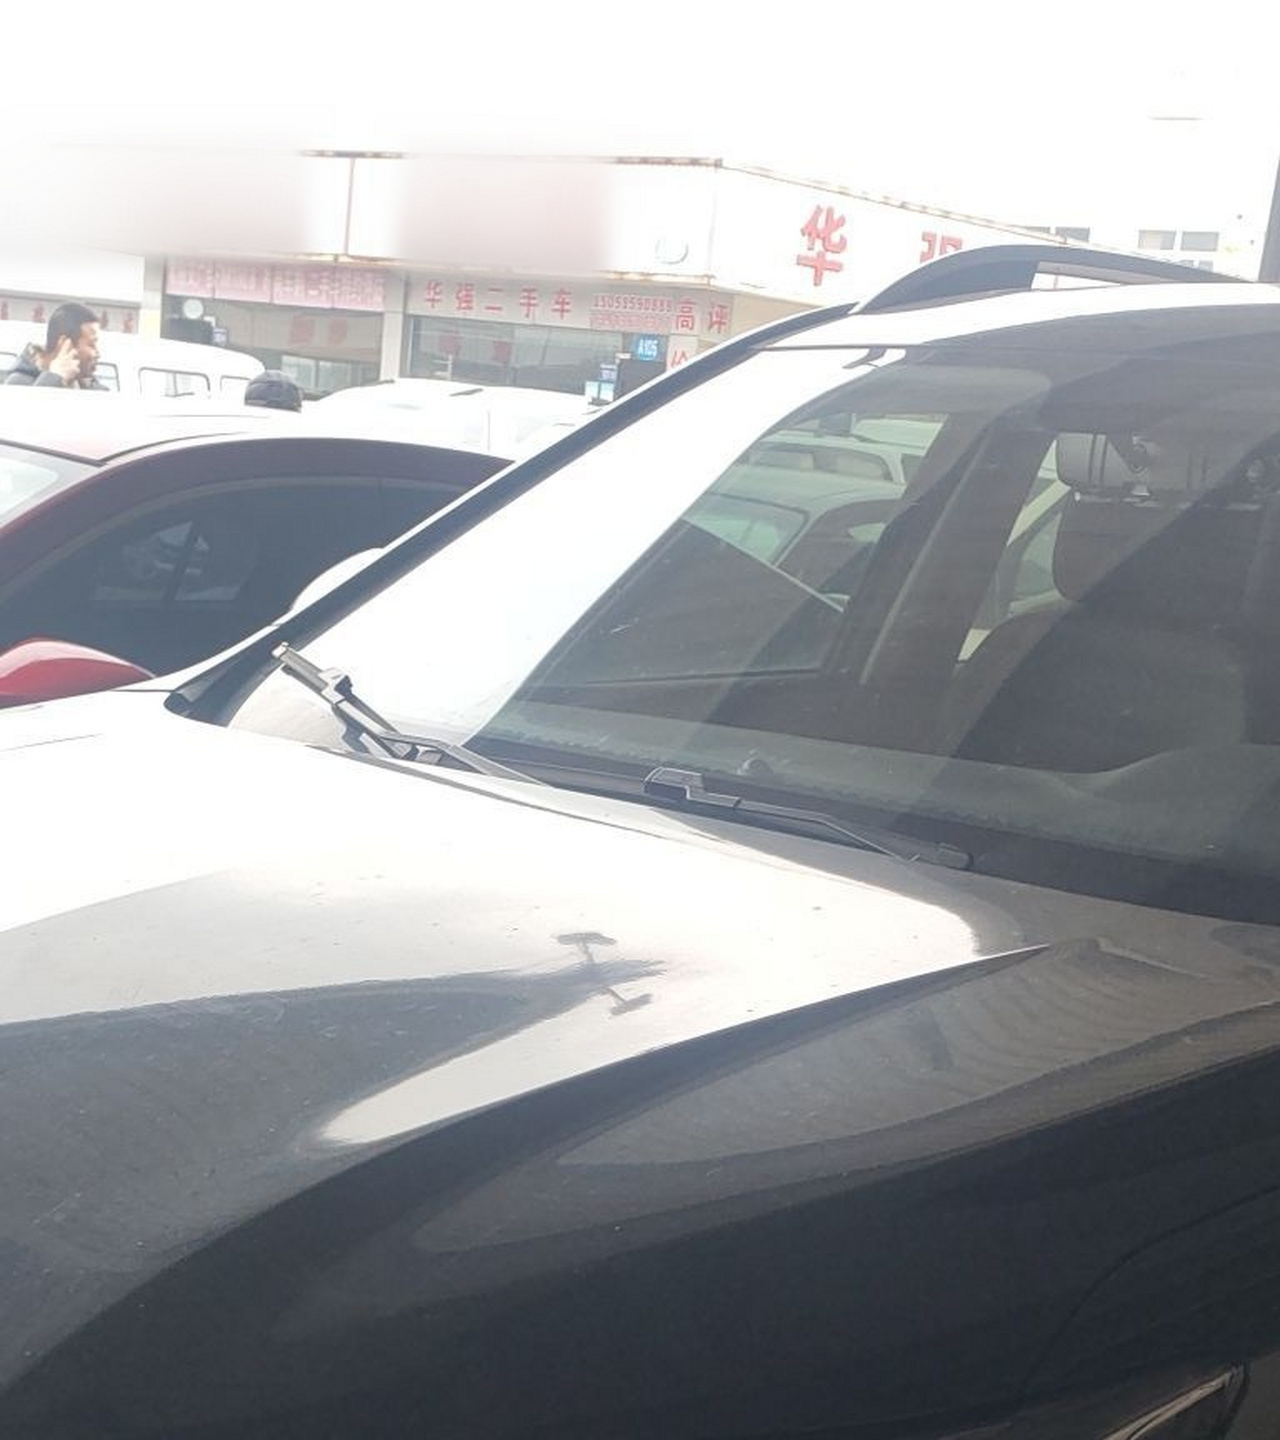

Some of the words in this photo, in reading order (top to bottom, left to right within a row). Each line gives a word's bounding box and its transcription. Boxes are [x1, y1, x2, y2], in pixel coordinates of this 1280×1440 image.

[424, 279, 573, 320] 华强二手车
